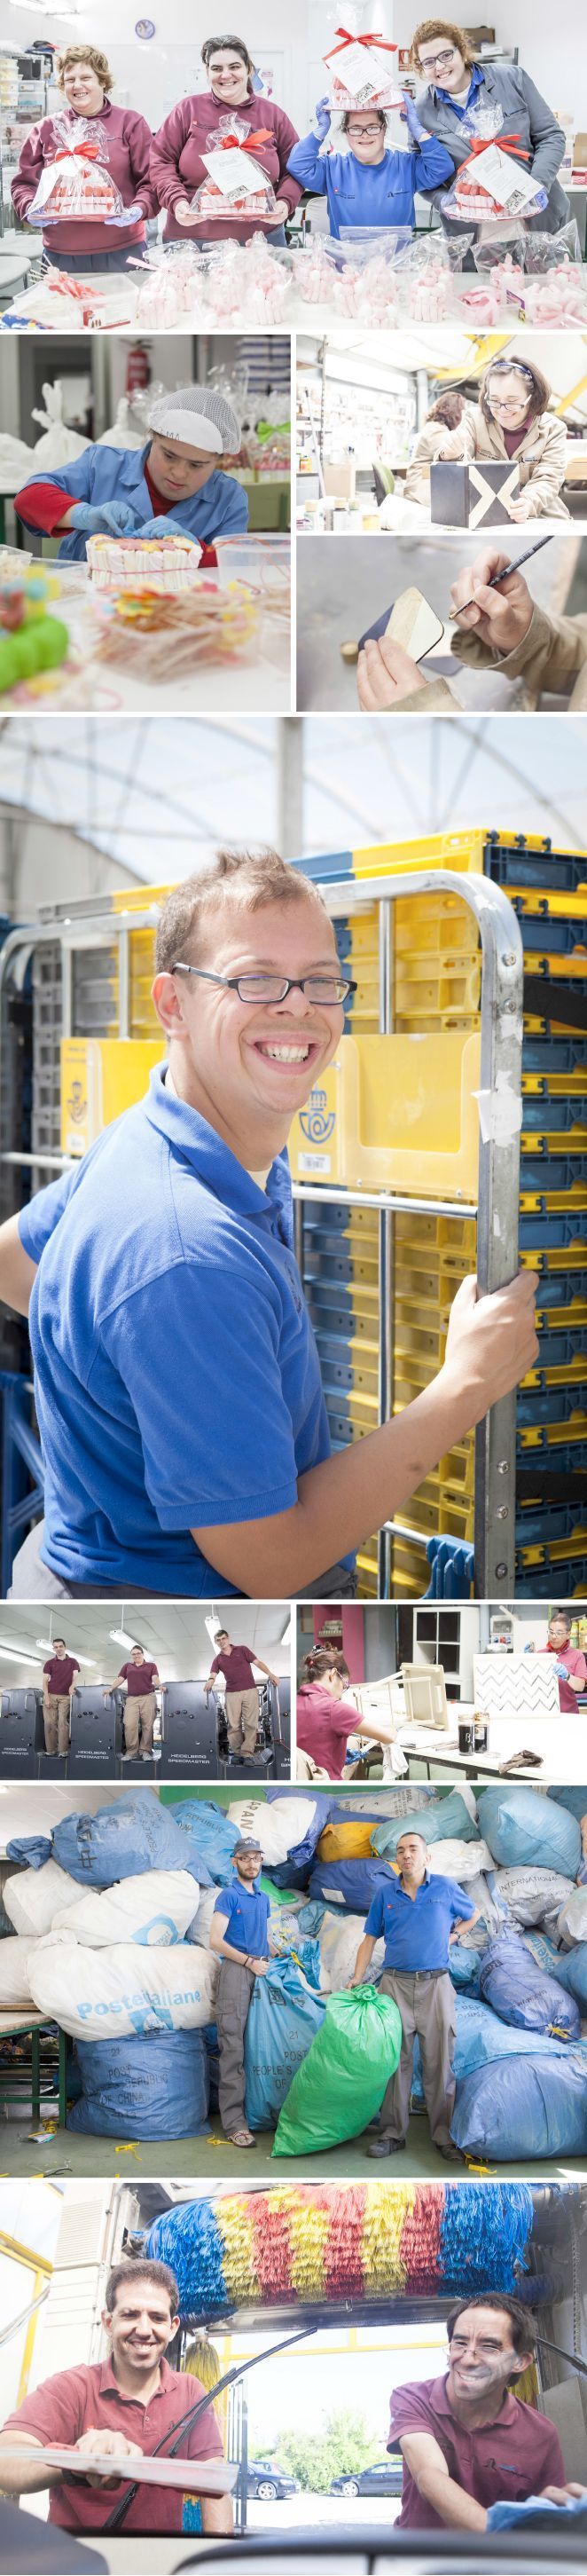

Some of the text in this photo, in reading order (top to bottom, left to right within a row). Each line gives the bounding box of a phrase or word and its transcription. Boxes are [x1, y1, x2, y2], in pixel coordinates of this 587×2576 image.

[289, 2030, 299, 2040] 21
[284, 2050, 308, 2061] POST
[108, 2065, 132, 2081] POST
[252, 2064, 293, 2076] PEOPLE'S
[275, 2078, 286, 2090] OF
[118, 2092, 144, 2105] CHINA
